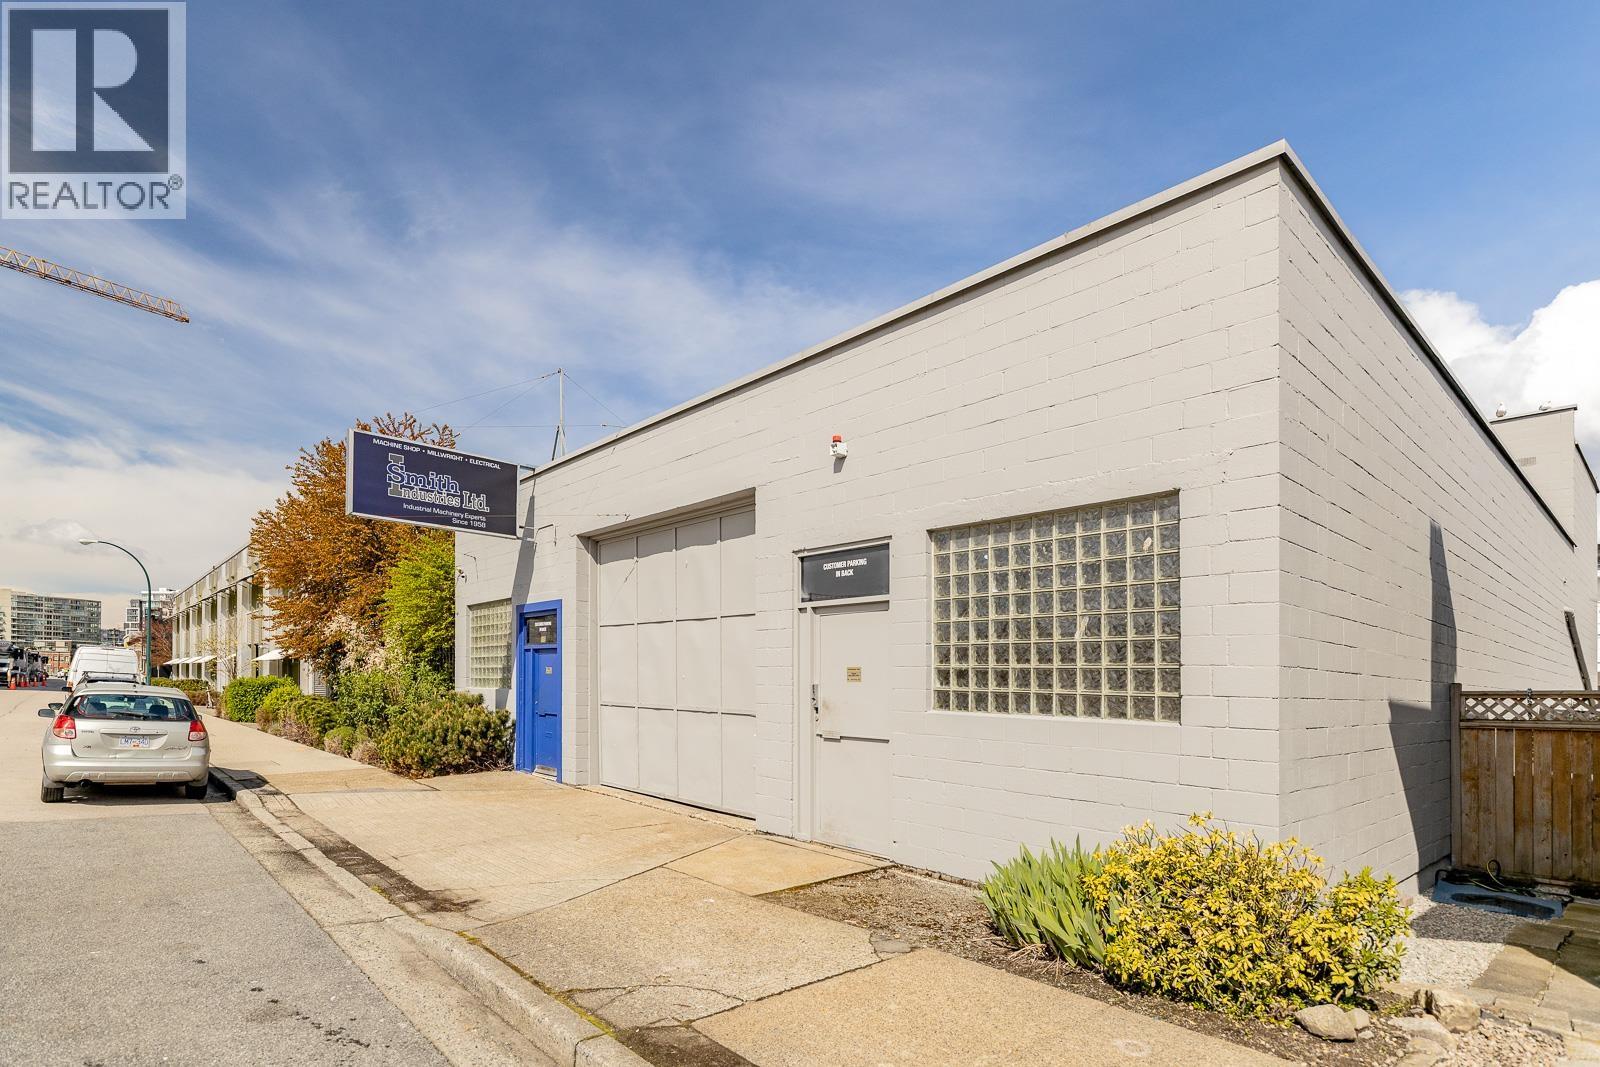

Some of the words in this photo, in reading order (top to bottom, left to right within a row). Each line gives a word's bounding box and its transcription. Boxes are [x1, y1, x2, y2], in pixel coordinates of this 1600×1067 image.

[372, 438, 403, 450] MACHINE
[403, 444, 421, 453] SHOP
[427, 449, 464, 462] MILLWRIGHT
[469, 458, 501, 470] ELECTRICAL
[387, 463, 461, 495] Smith
[462, 490, 490, 513] Ltd.
[402, 502, 432, 513] Industrial
[432, 507, 464, 519] Machinery
[464, 512, 487, 522] Experts
[451, 517, 469, 526] Since
[470, 520, 487, 529] 1958
[823, 560, 846, 570] CUSTOMER
[847, 558, 867, 567] PARKING
[841, 569, 854, 577] BACK
